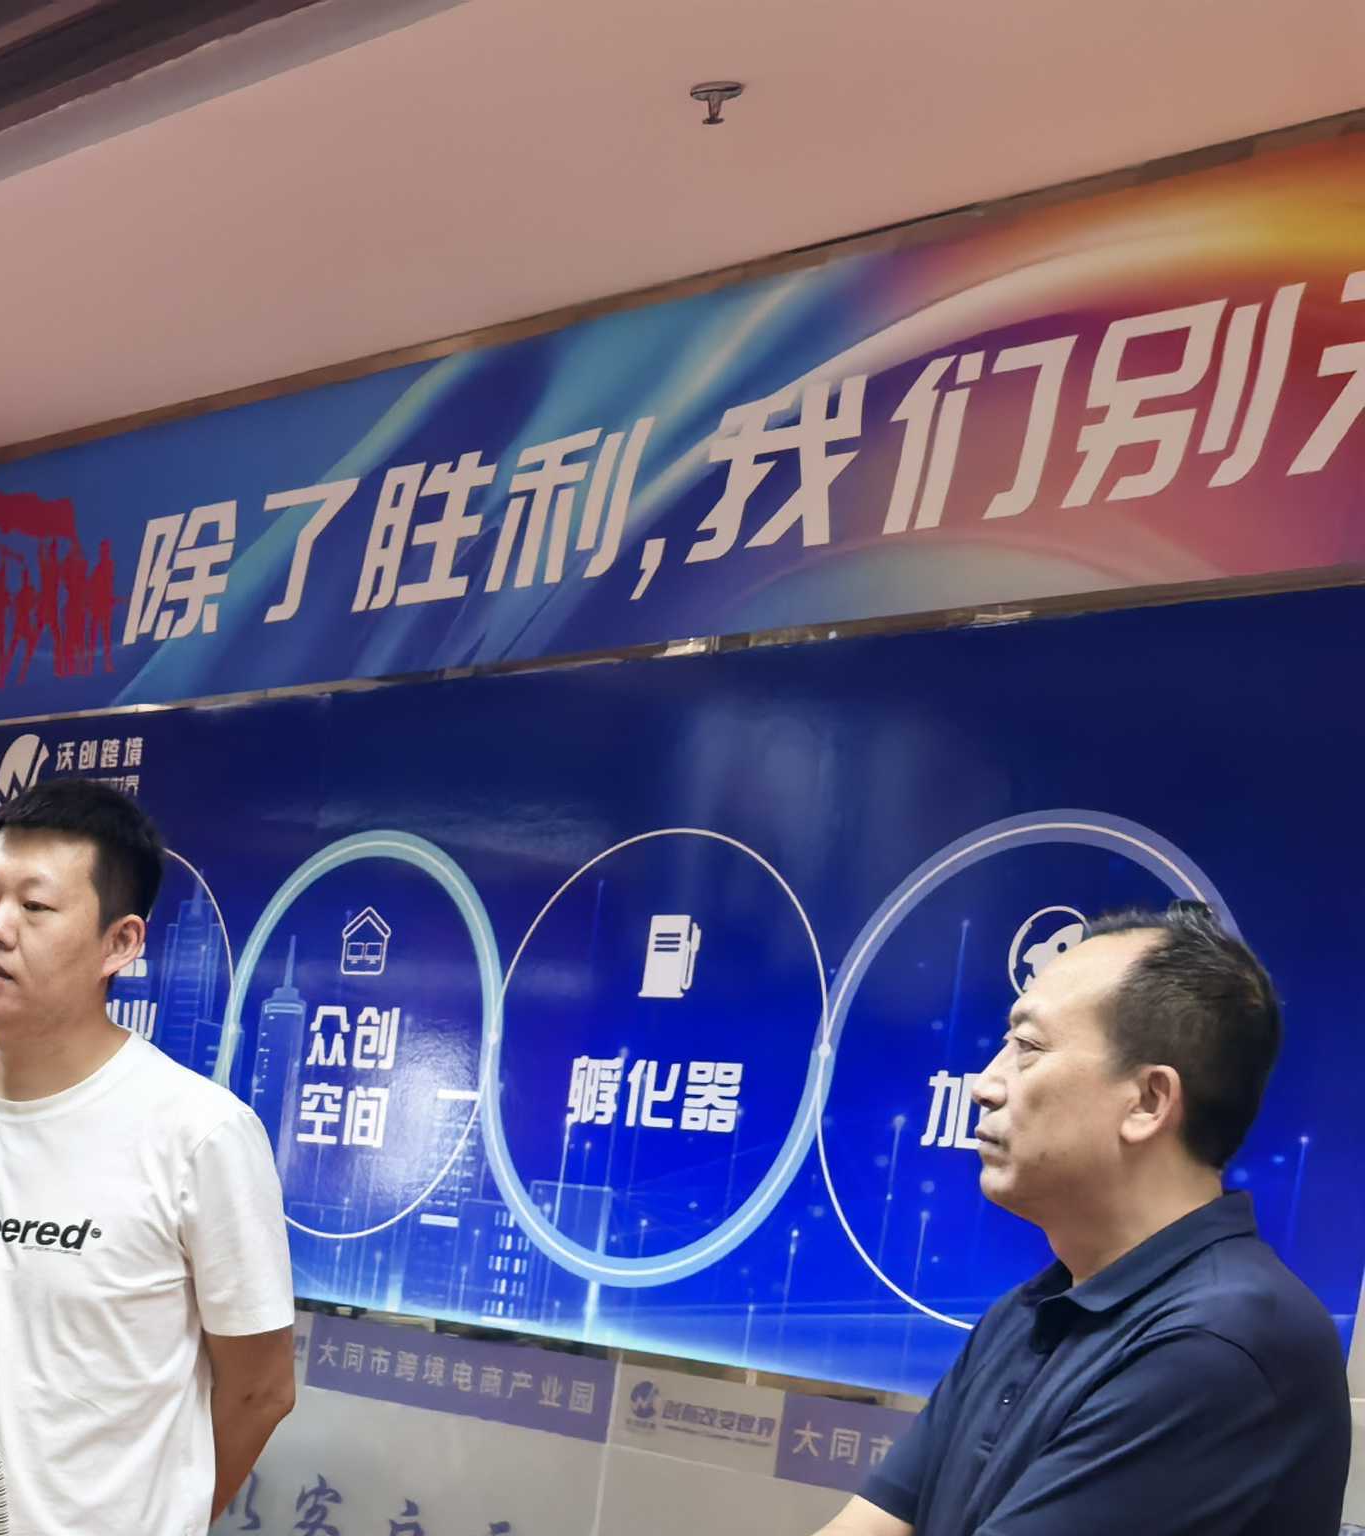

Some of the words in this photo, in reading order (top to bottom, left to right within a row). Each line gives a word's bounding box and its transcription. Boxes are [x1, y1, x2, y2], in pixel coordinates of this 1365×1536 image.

[55, 737, 144, 772] 沃创跨境
[307, 1005, 401, 1070] 众创
[296, 1081, 389, 1150] 空间
[566, 1055, 744, 1134] 孵化器
[317, 1336, 597, 1417] 大同市跨境电商产业园
